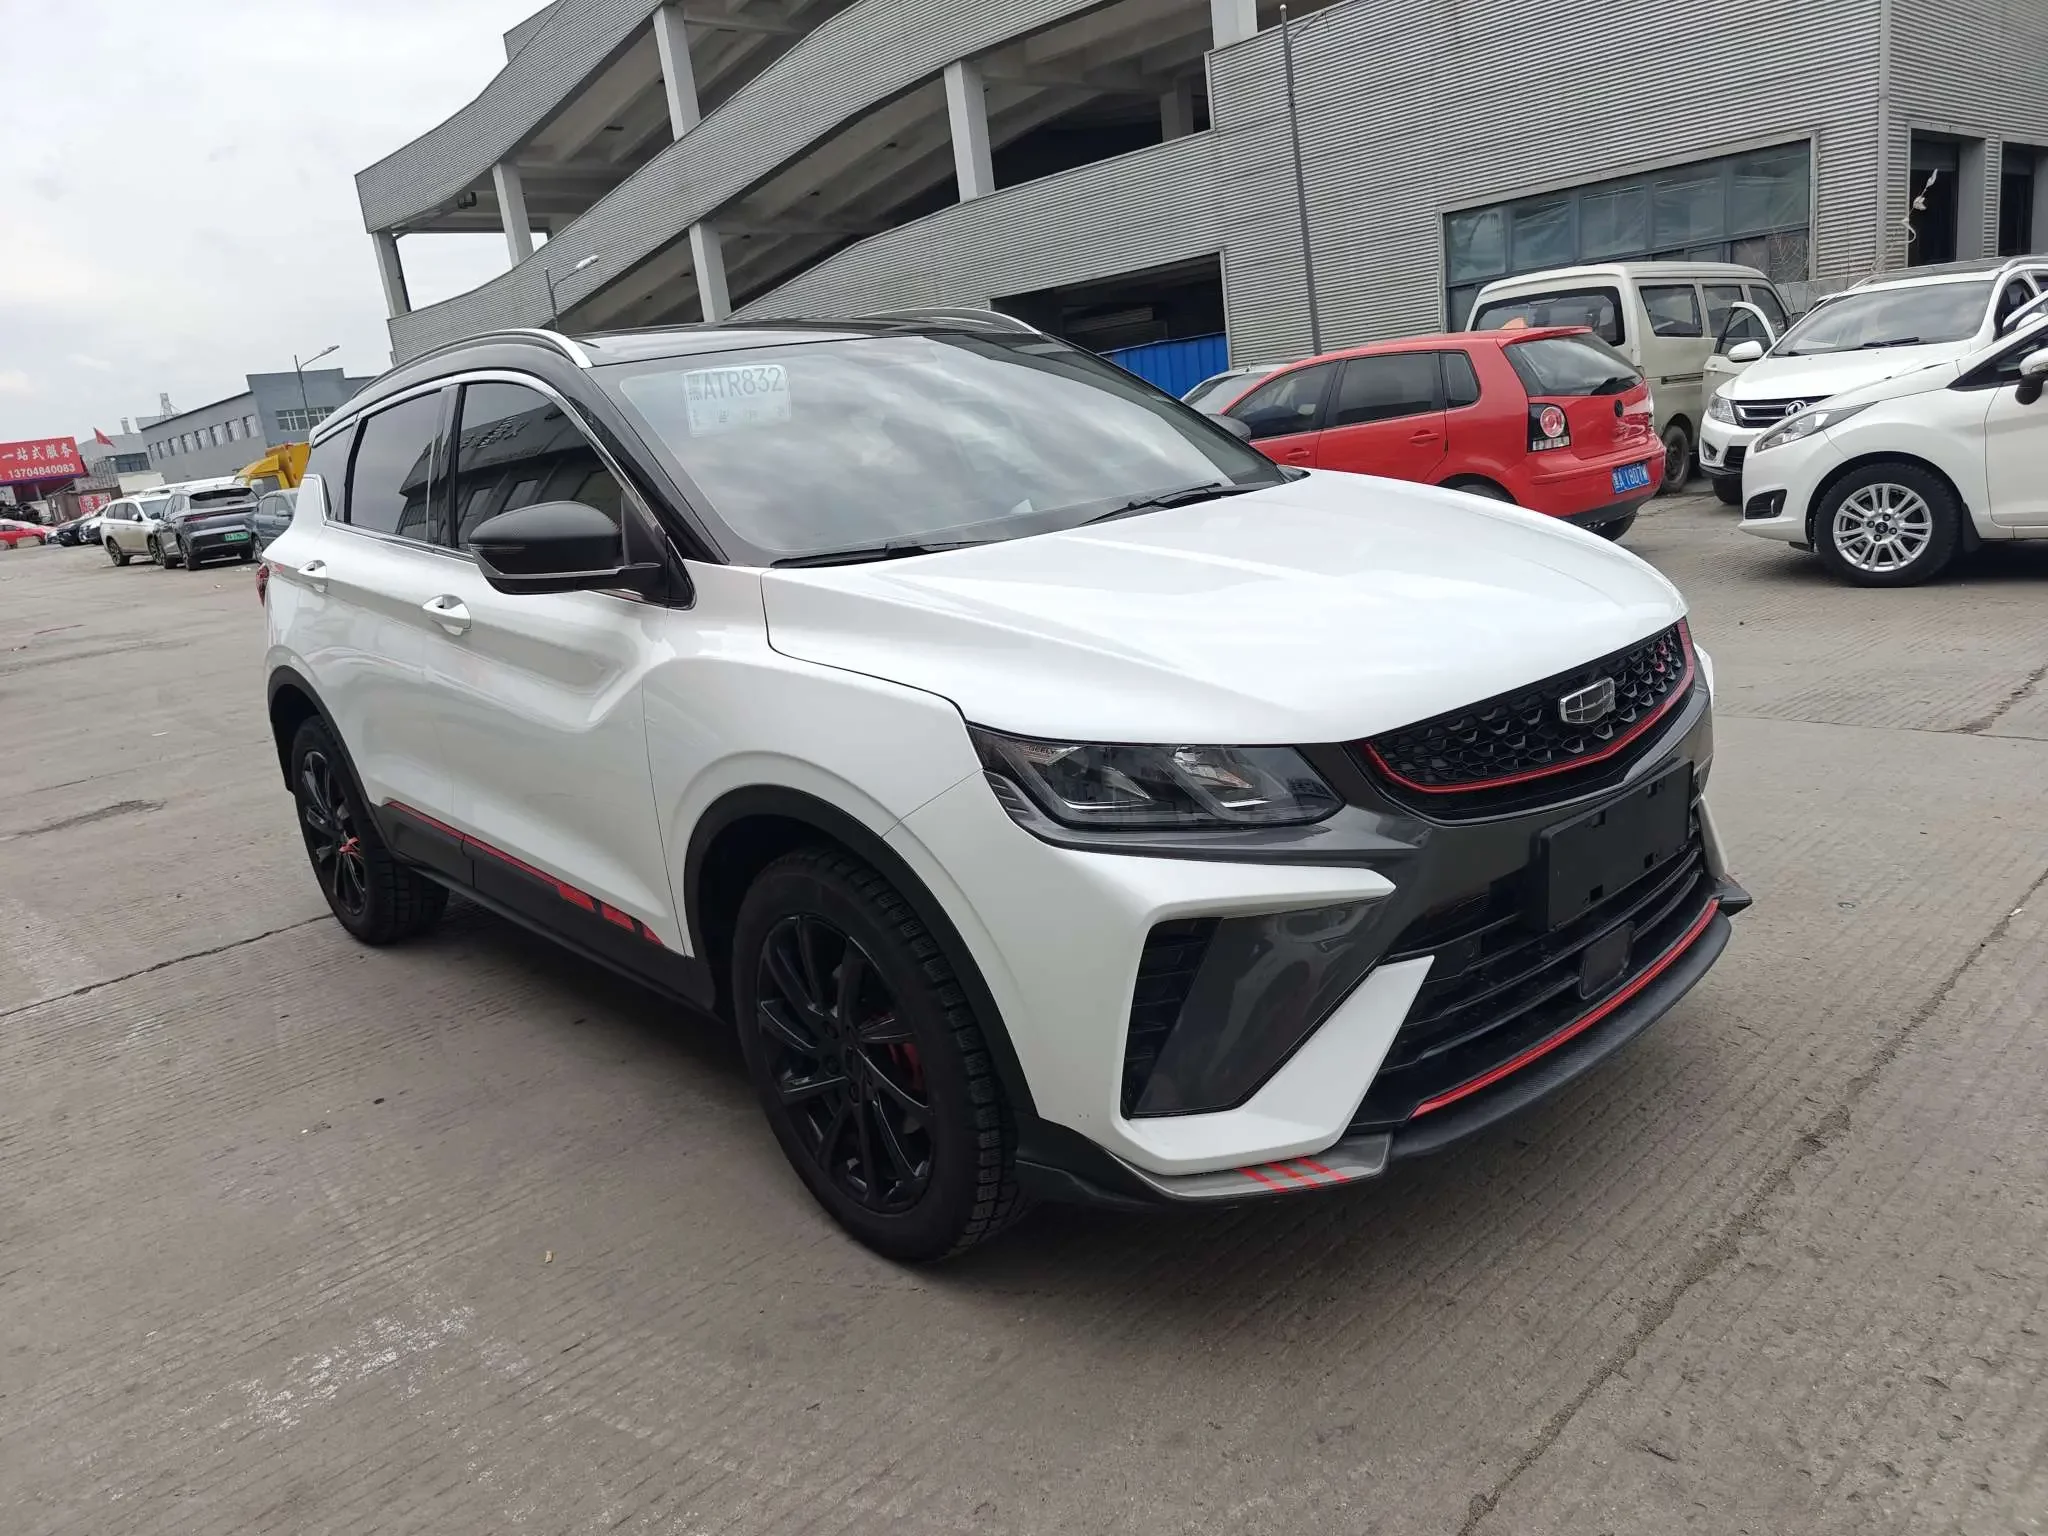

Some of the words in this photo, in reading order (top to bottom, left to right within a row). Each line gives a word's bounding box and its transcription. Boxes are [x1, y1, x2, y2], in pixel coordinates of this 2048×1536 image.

[2, 443, 73, 461] 一站式服务
